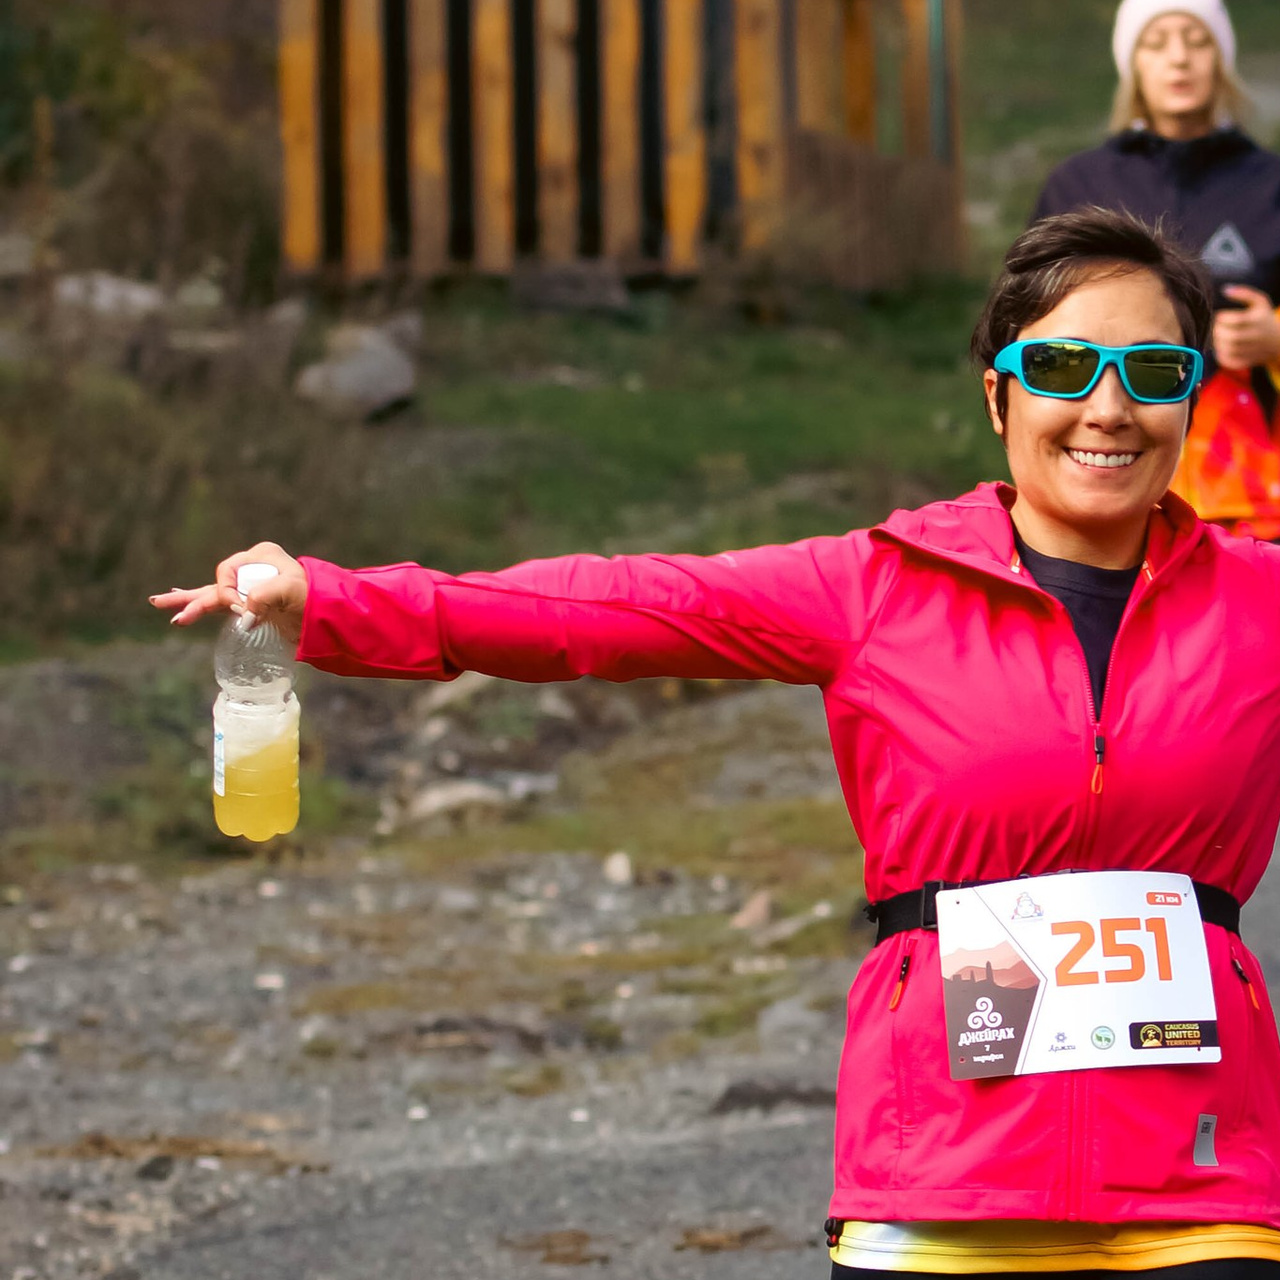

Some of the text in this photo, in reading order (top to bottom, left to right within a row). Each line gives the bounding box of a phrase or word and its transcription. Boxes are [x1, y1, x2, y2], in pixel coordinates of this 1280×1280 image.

[1154, 894, 1165, 902] 21
[1051, 917, 1173, 987] 251
[958, 1027, 1015, 1047] ДЖЕЙРАХ
[1165, 1030, 1201, 1039] UNITED
